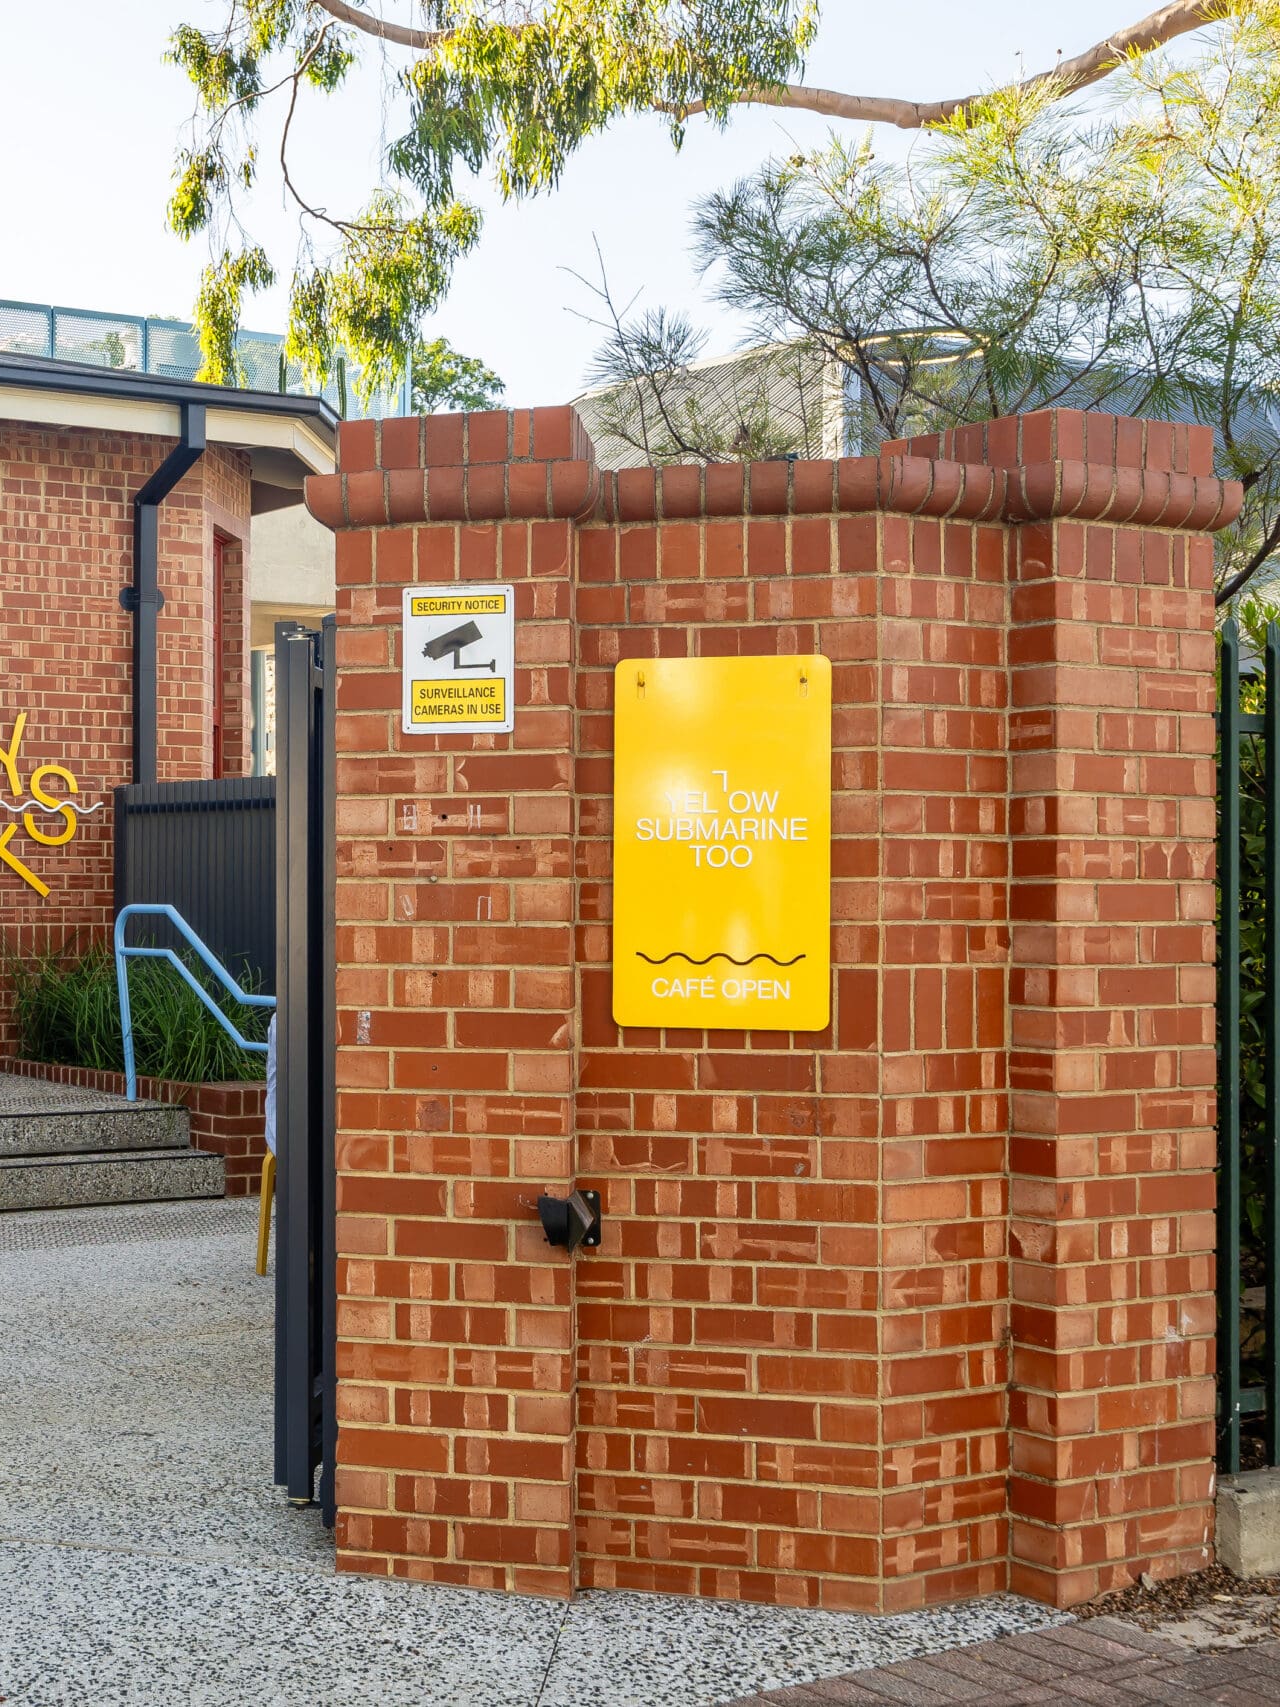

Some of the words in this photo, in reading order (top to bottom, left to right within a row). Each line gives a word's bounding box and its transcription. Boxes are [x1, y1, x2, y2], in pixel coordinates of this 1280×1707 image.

[417, 600, 463, 612] SECURITY
[465, 599, 500, 610] NOTICE
[419, 686, 496, 699] SURVEILLANCE
[414, 704, 464, 716] CAMERAS
[467, 704, 478, 715] IN
[480, 703, 501, 715] USE
[636, 817, 808, 841] SUBMARINE
[688, 844, 753, 868] TOO
[651, 975, 716, 999] CAFÉ
[721, 979, 791, 1000] OPEN
